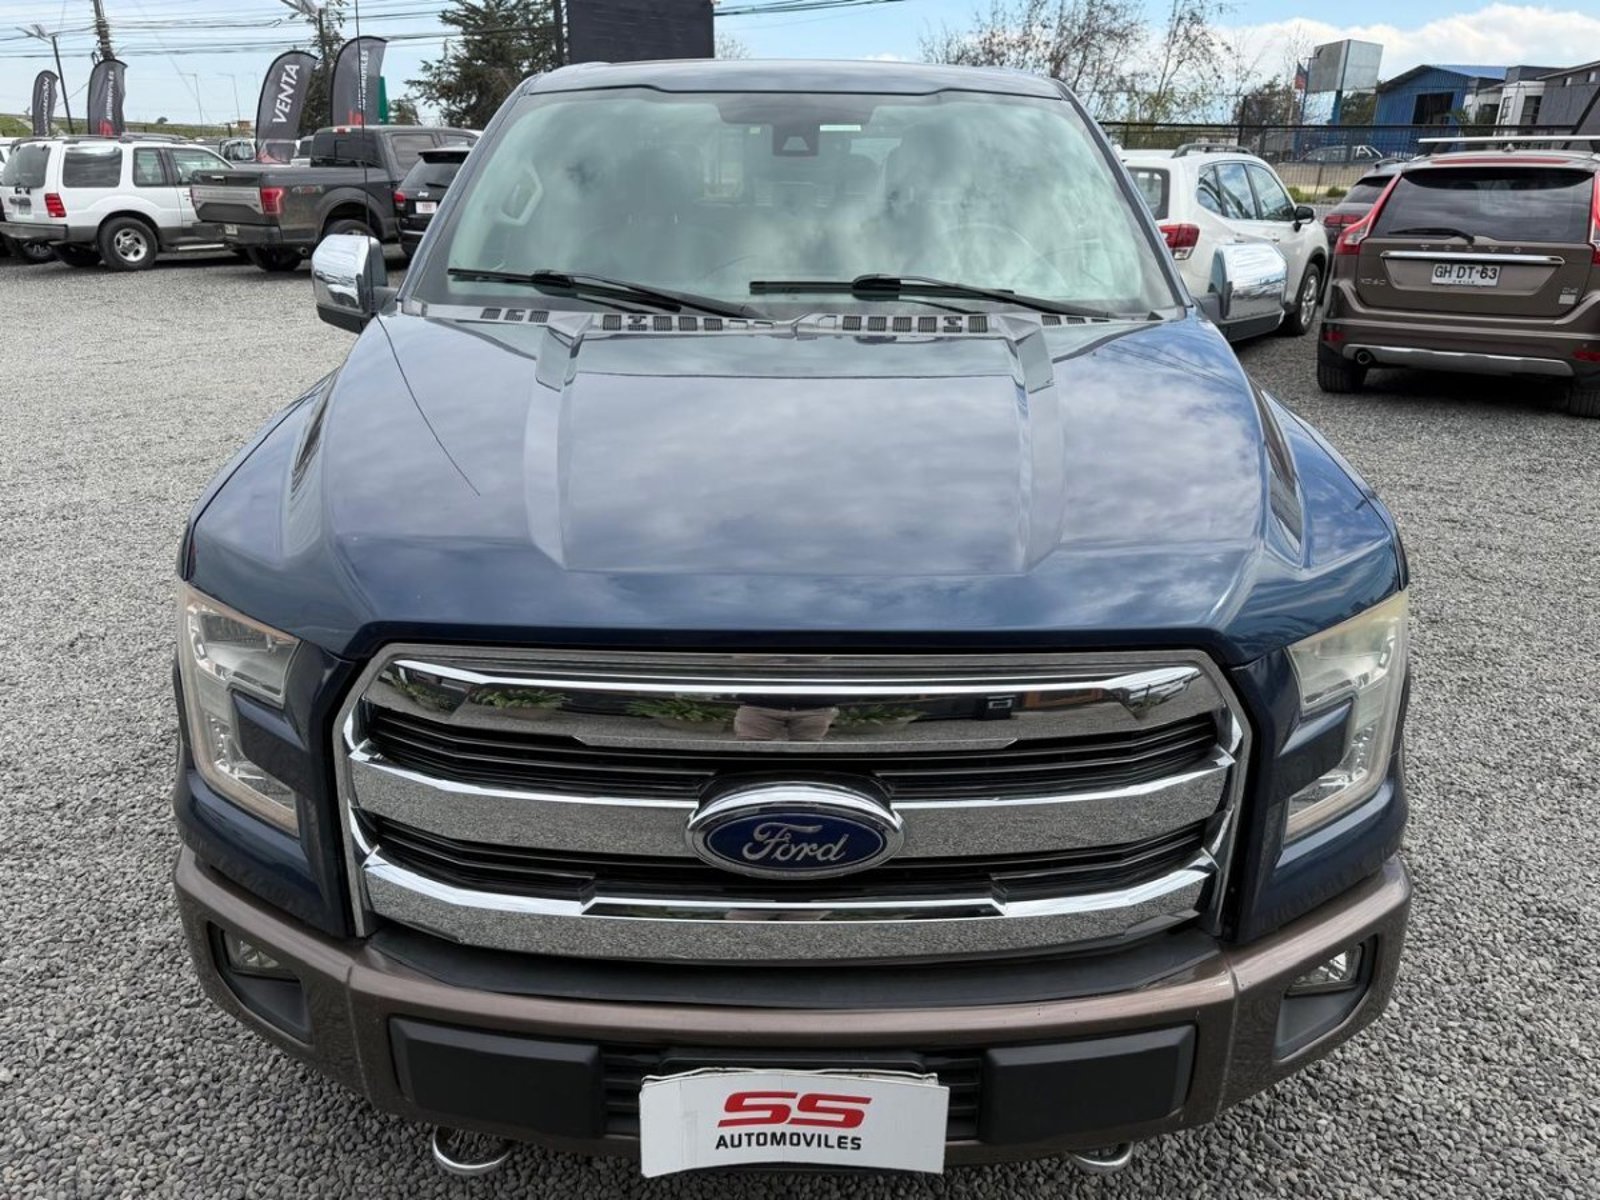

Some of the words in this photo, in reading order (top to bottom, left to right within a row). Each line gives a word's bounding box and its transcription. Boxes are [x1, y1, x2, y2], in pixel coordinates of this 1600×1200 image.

[271, 64, 300, 123] VENTA
[741, 821, 849, 862] Ford
[717, 1090, 873, 1129] SS
[715, 1131, 863, 1151] AUTOMOVILES
